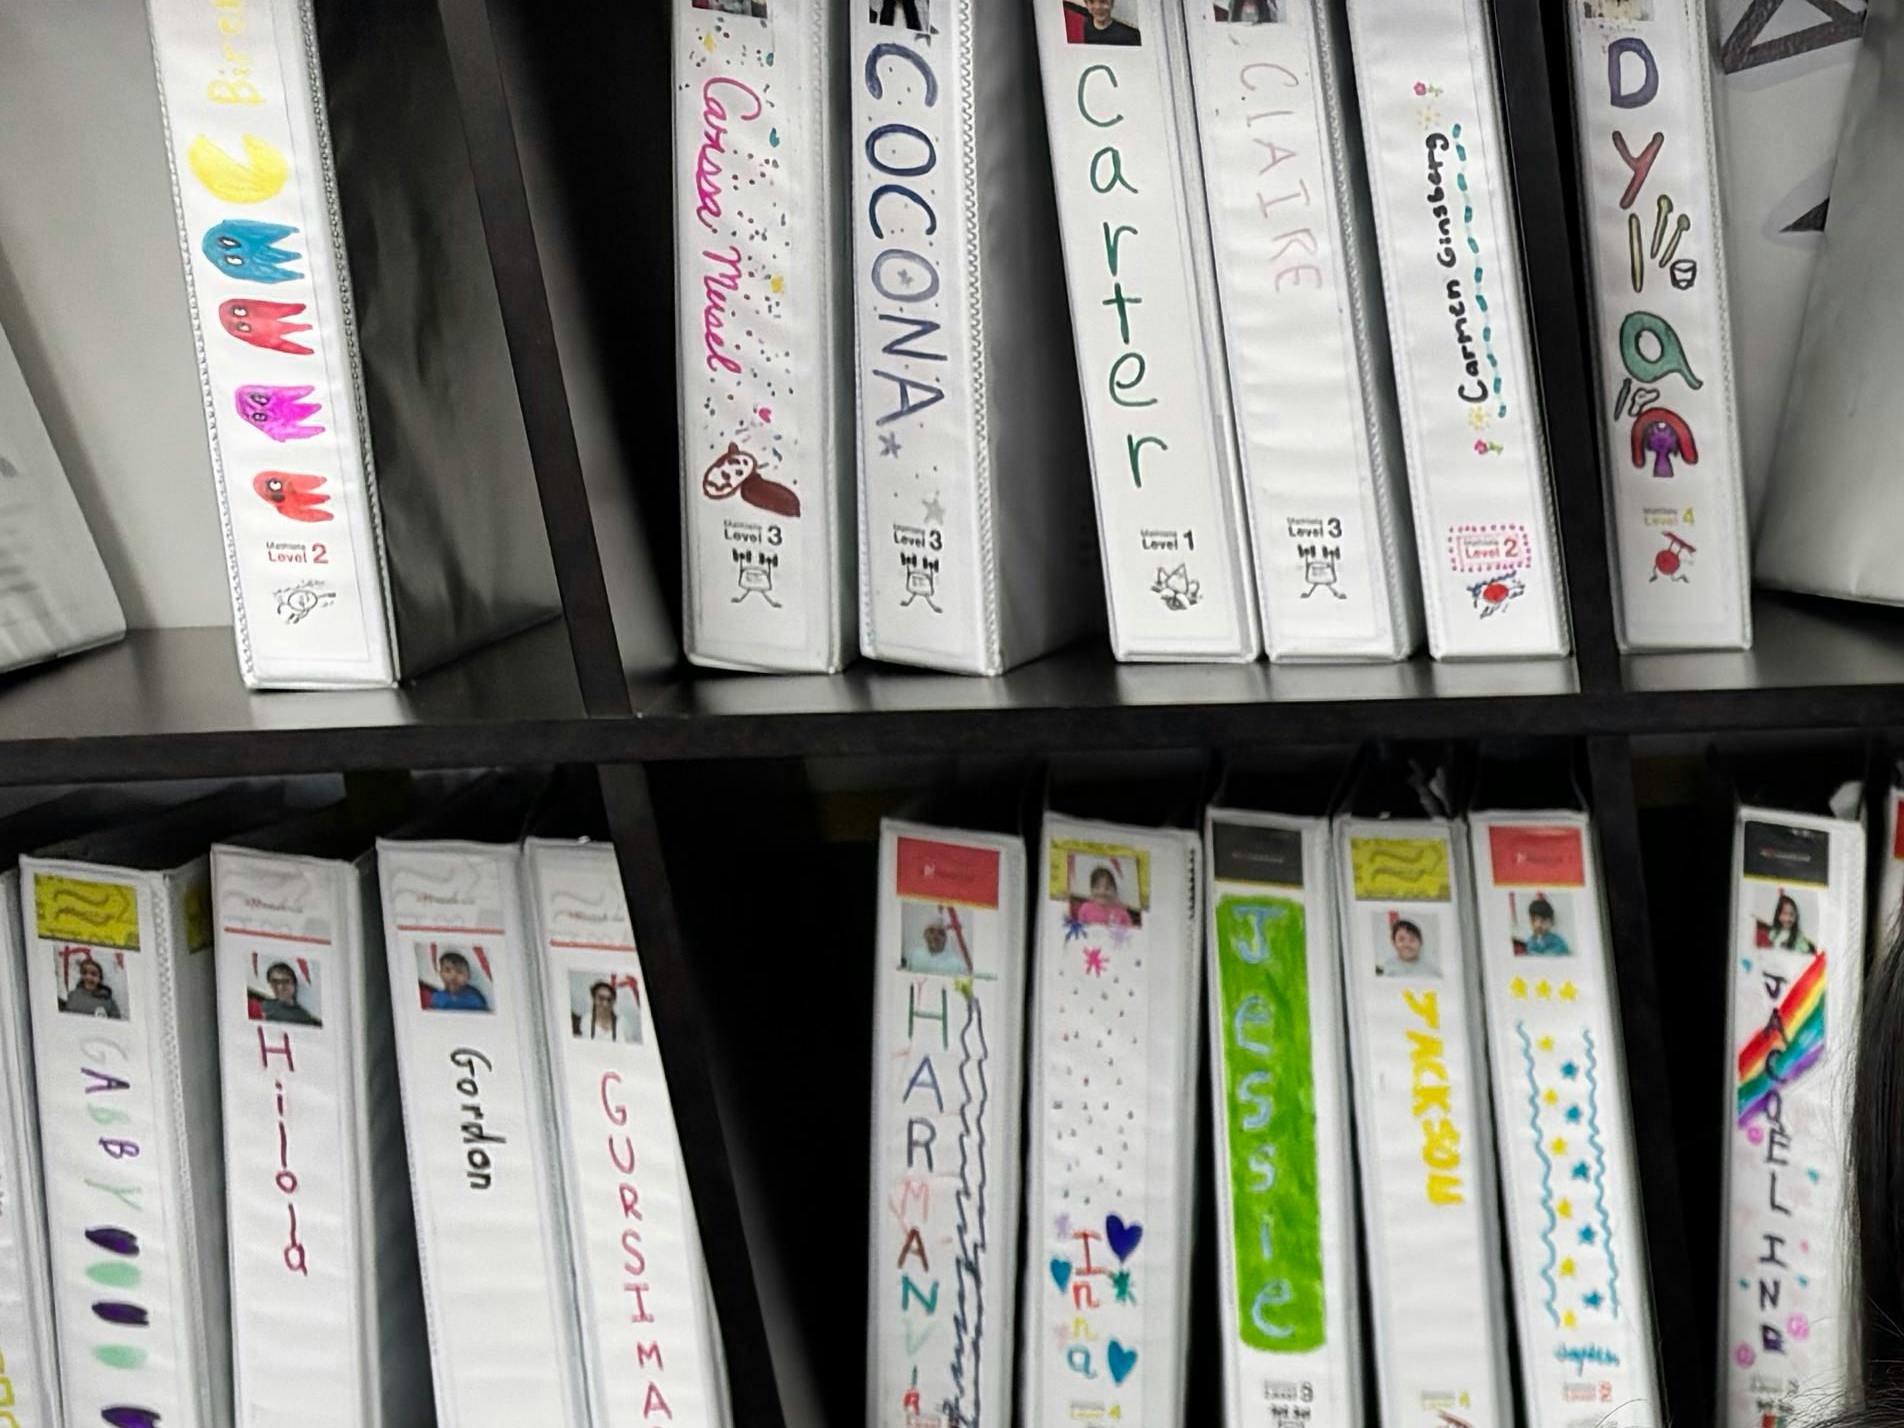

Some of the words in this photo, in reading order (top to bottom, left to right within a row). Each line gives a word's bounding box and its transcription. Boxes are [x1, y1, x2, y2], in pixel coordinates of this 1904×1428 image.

[862, 41, 948, 426] COCONA
[1425, 132, 1457, 268] Ginsberg
[1077, 64, 1167, 488] Carter
[1446, 268, 1488, 403] Carmen
[312, 543, 329, 564] 2
[768, 526, 782, 546] 3
[930, 530, 942, 551] 3
[1183, 530, 1195, 551] 1
[1328, 518, 1342, 538] 3
[1504, 539, 1518, 557] 2
[1683, 508, 1694, 525] 4
[77, 1036, 140, 1212] GABBY
[450, 1045, 507, 1191] Gordon
[1231, 904, 1296, 1339] Jessie
[1066, 1229, 1103, 1374] Inna
